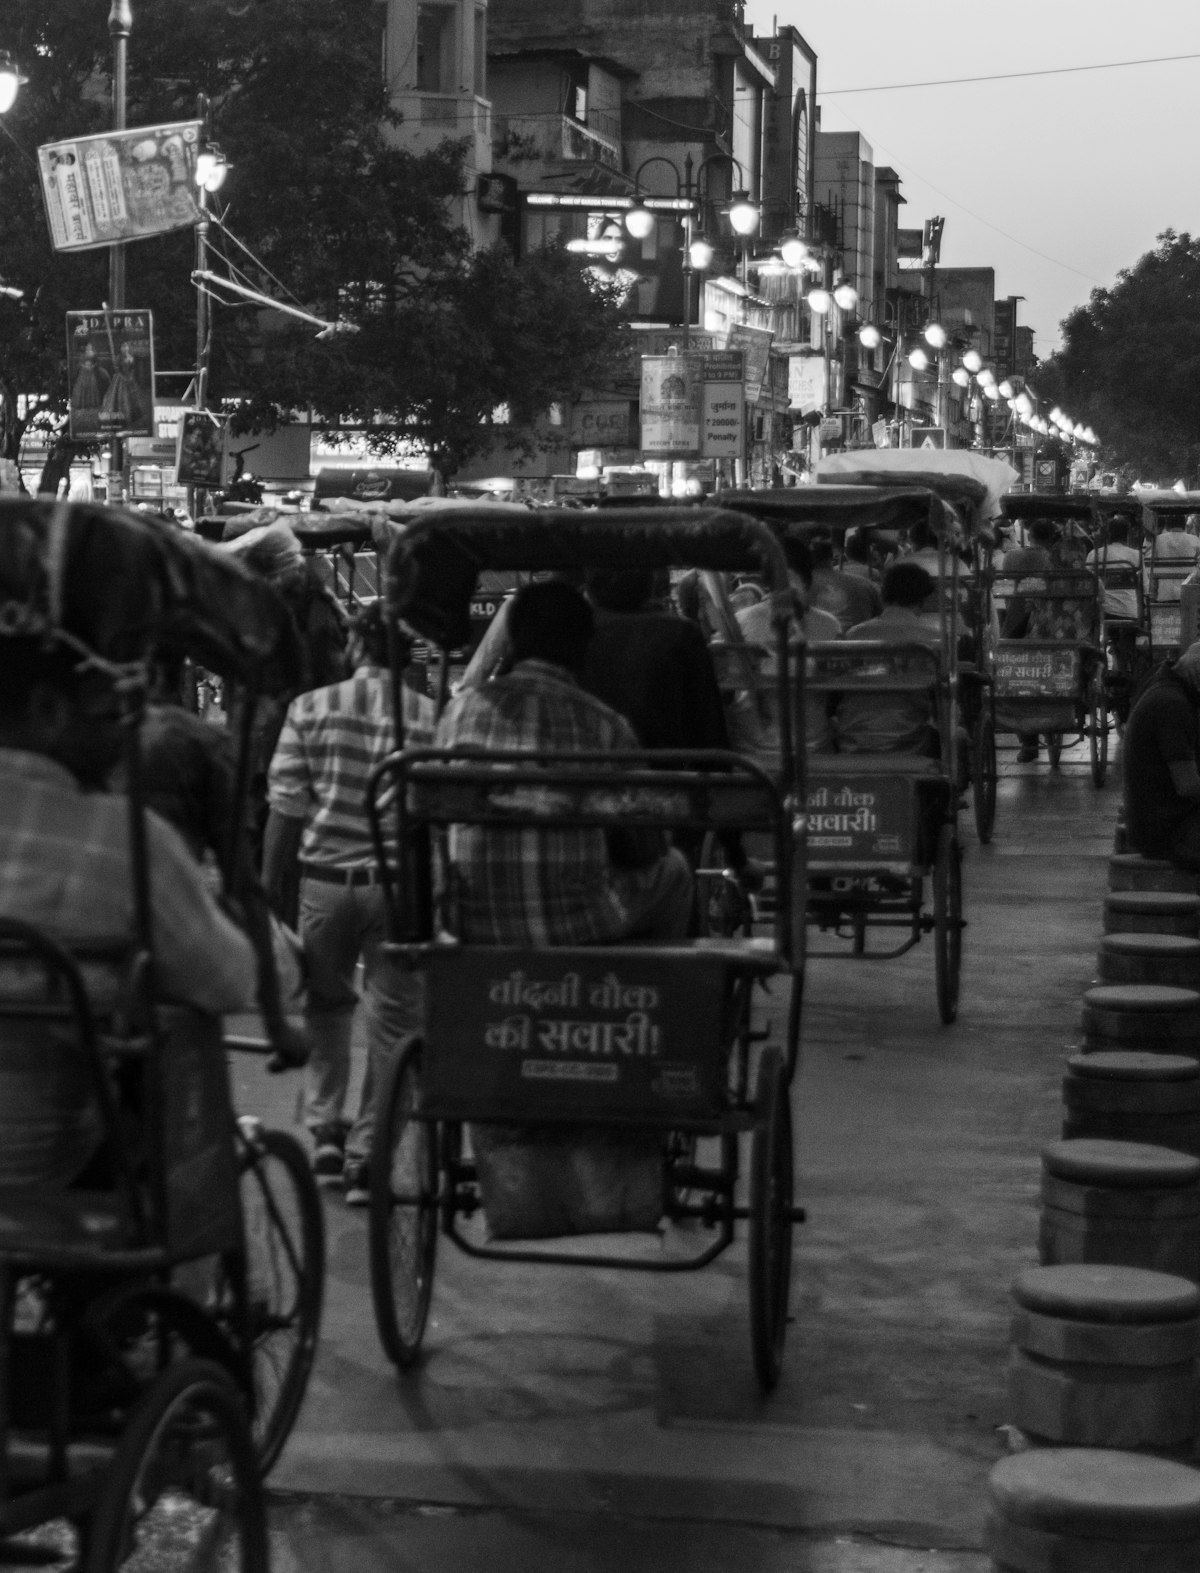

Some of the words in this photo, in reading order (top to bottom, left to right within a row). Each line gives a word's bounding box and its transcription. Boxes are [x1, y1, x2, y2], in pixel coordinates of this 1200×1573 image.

[527, 195, 553, 204] WELCOME
[581, 198, 601, 206] BARODA
[602, 199, 616, 207] TOWN
[710, 400, 737, 413] जुर्माना
[707, 432, 737, 443] Penalty
[833, 785, 875, 807] चौक
[806, 807, 877, 832] सवारी!
[587, 970, 660, 1010] चौक
[485, 1013, 531, 1051] की
[537, 1011, 660, 1056] सवारी!
